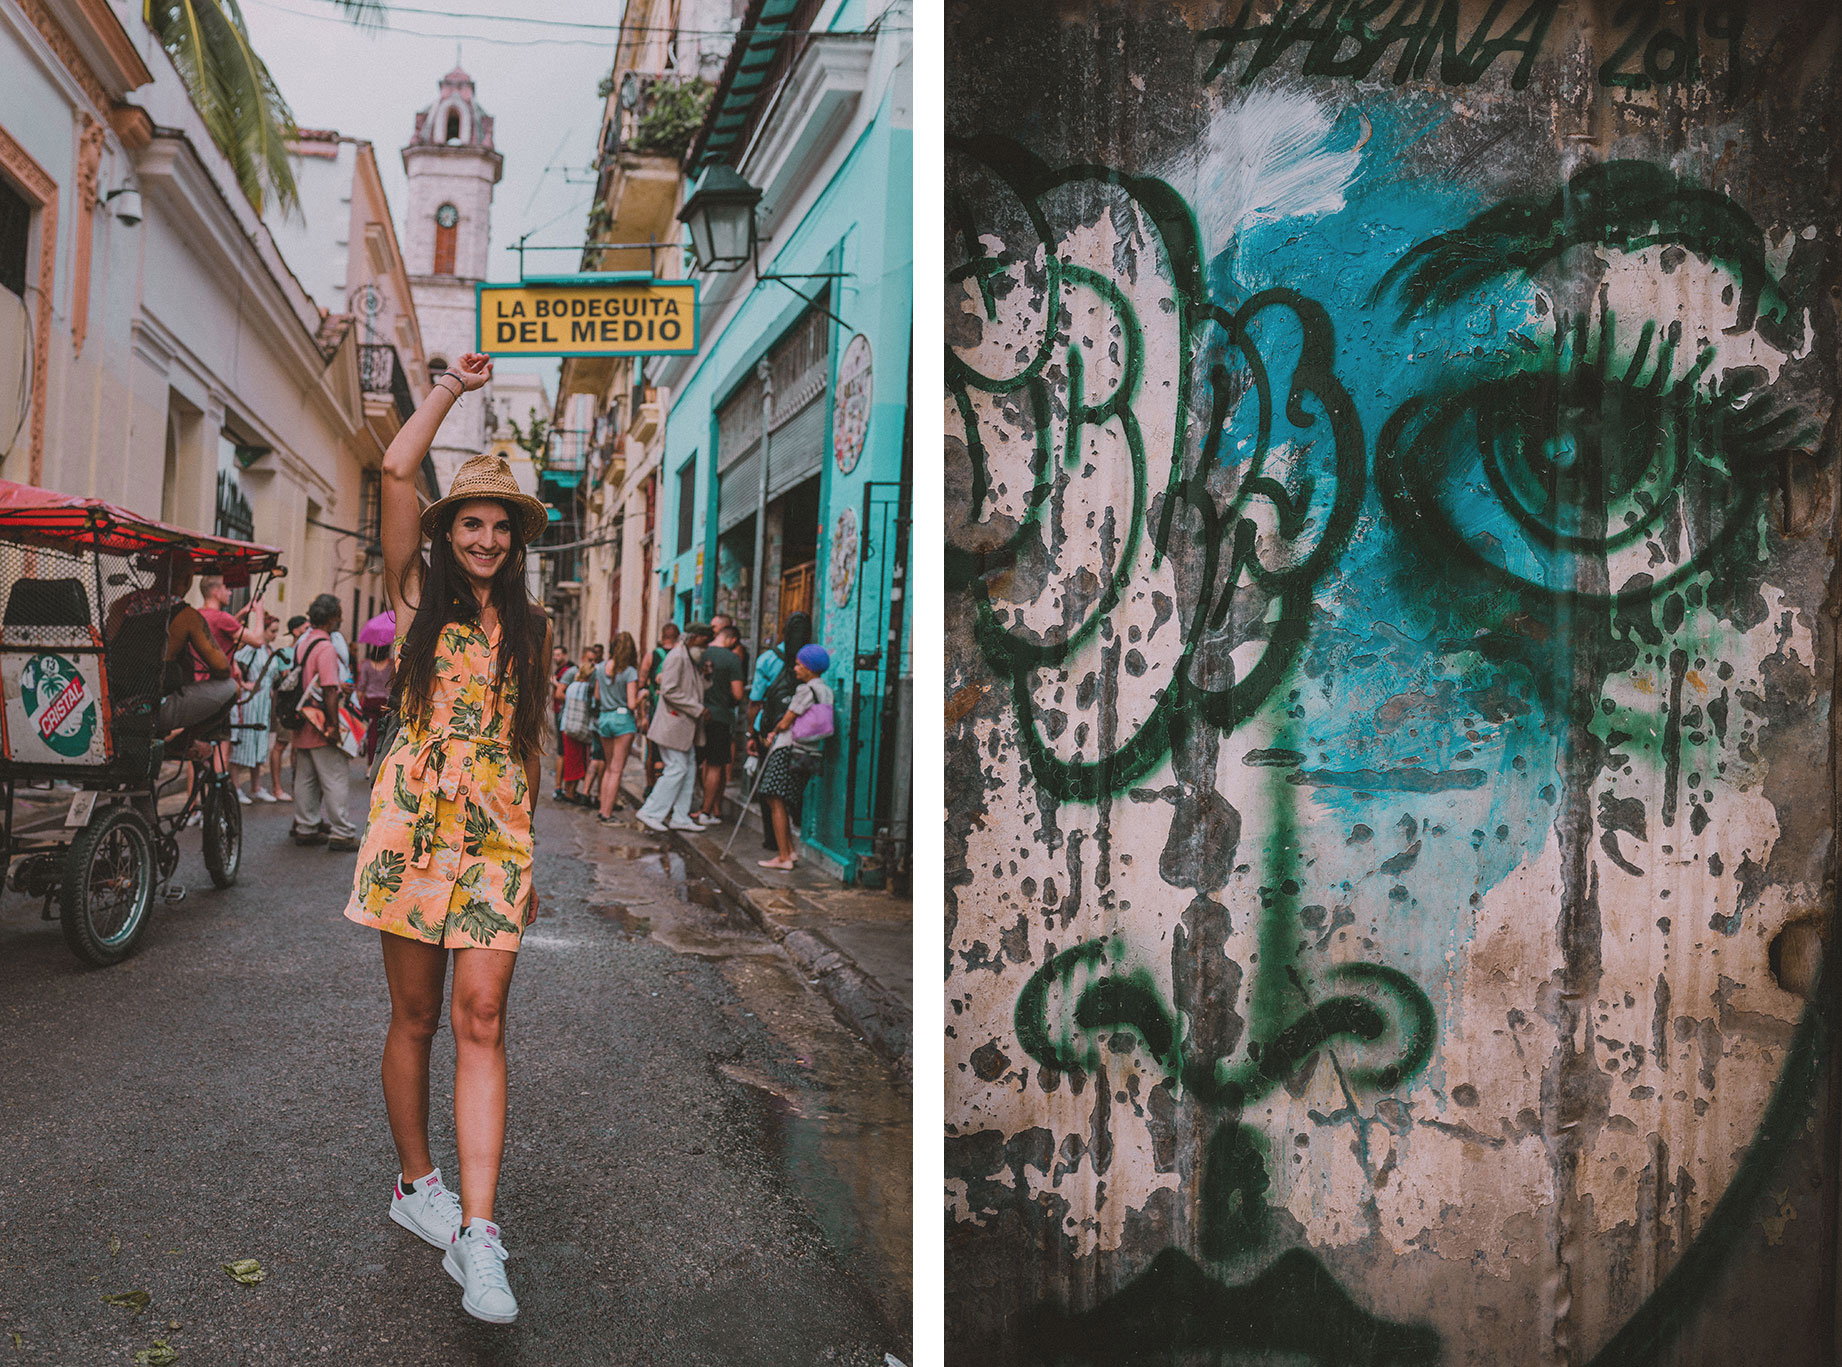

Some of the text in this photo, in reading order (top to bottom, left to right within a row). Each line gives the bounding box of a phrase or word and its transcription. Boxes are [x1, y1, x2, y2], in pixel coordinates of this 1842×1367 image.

[497, 298, 679, 318] LA BODEGUITA
[497, 319, 681, 343] DEL MEDIO
[41, 683, 83, 735] CRISTAL
